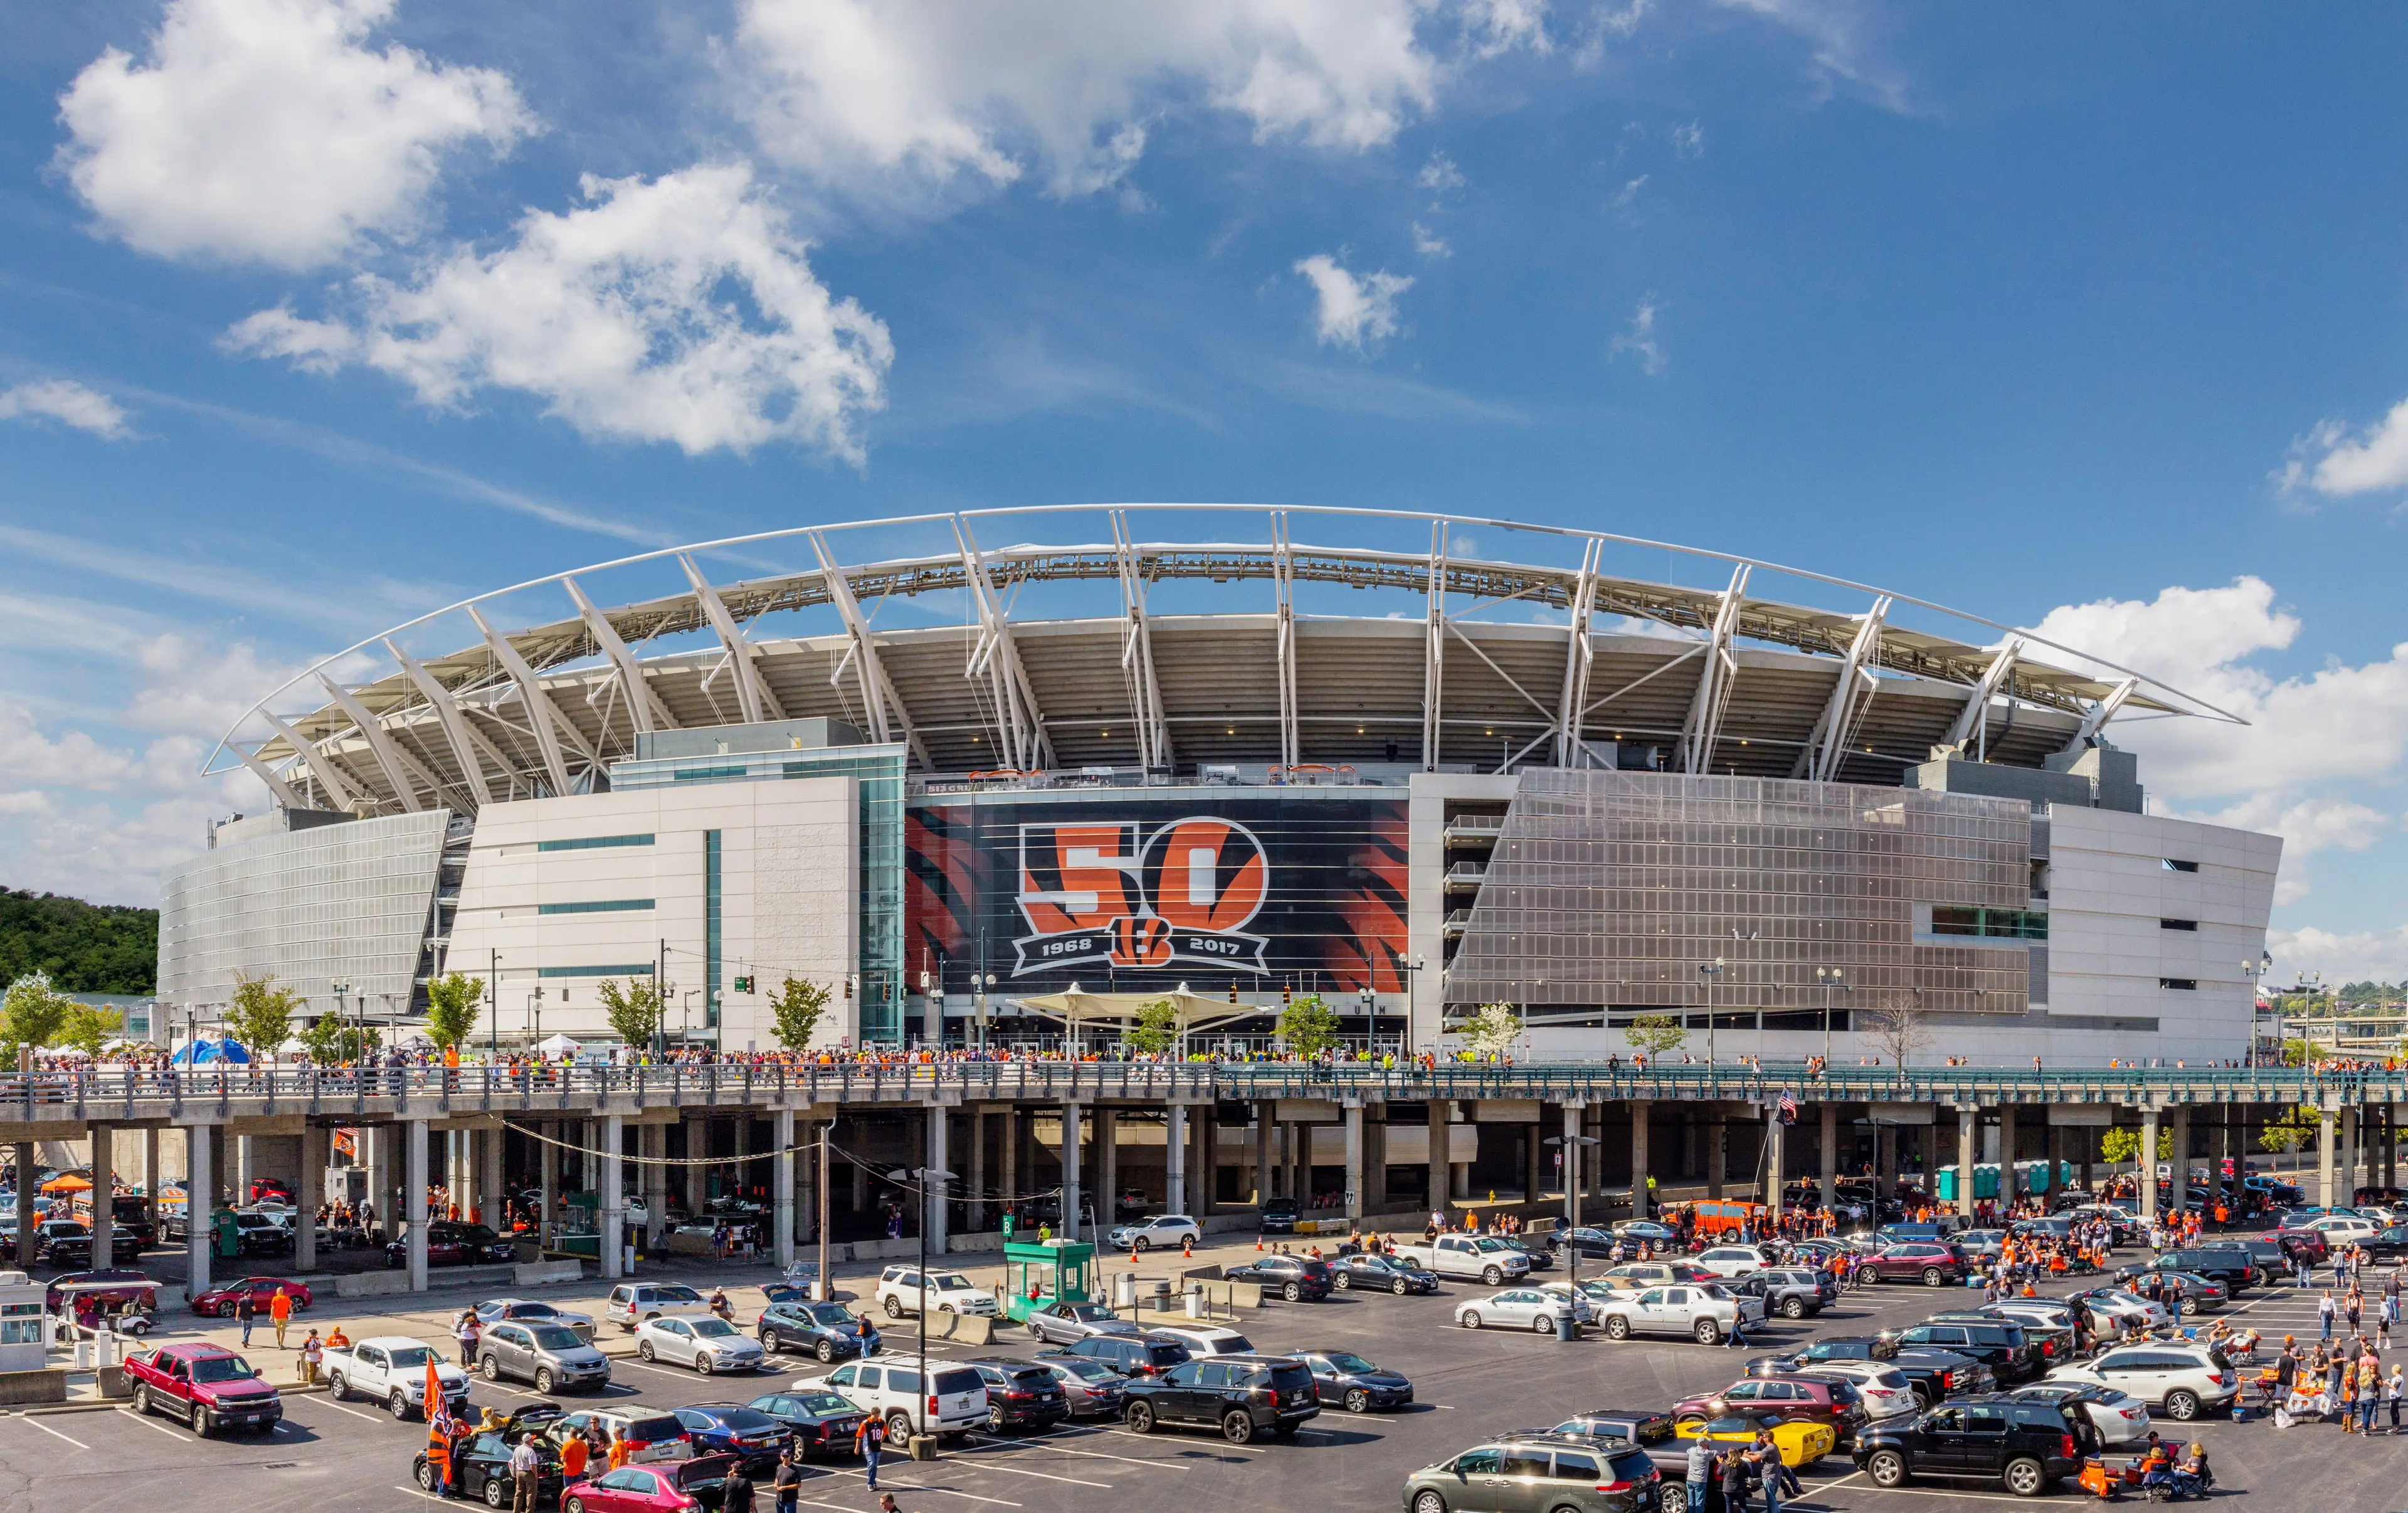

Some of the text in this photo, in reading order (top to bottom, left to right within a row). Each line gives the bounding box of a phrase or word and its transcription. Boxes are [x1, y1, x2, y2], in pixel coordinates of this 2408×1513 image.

[1015, 816, 1269, 936] 50
[1042, 938, 1092, 957] 1968
[1190, 938, 1240, 955] 2017
[1005, 1221, 1010, 1233] B
[871, 1428, 881, 1440] 18
